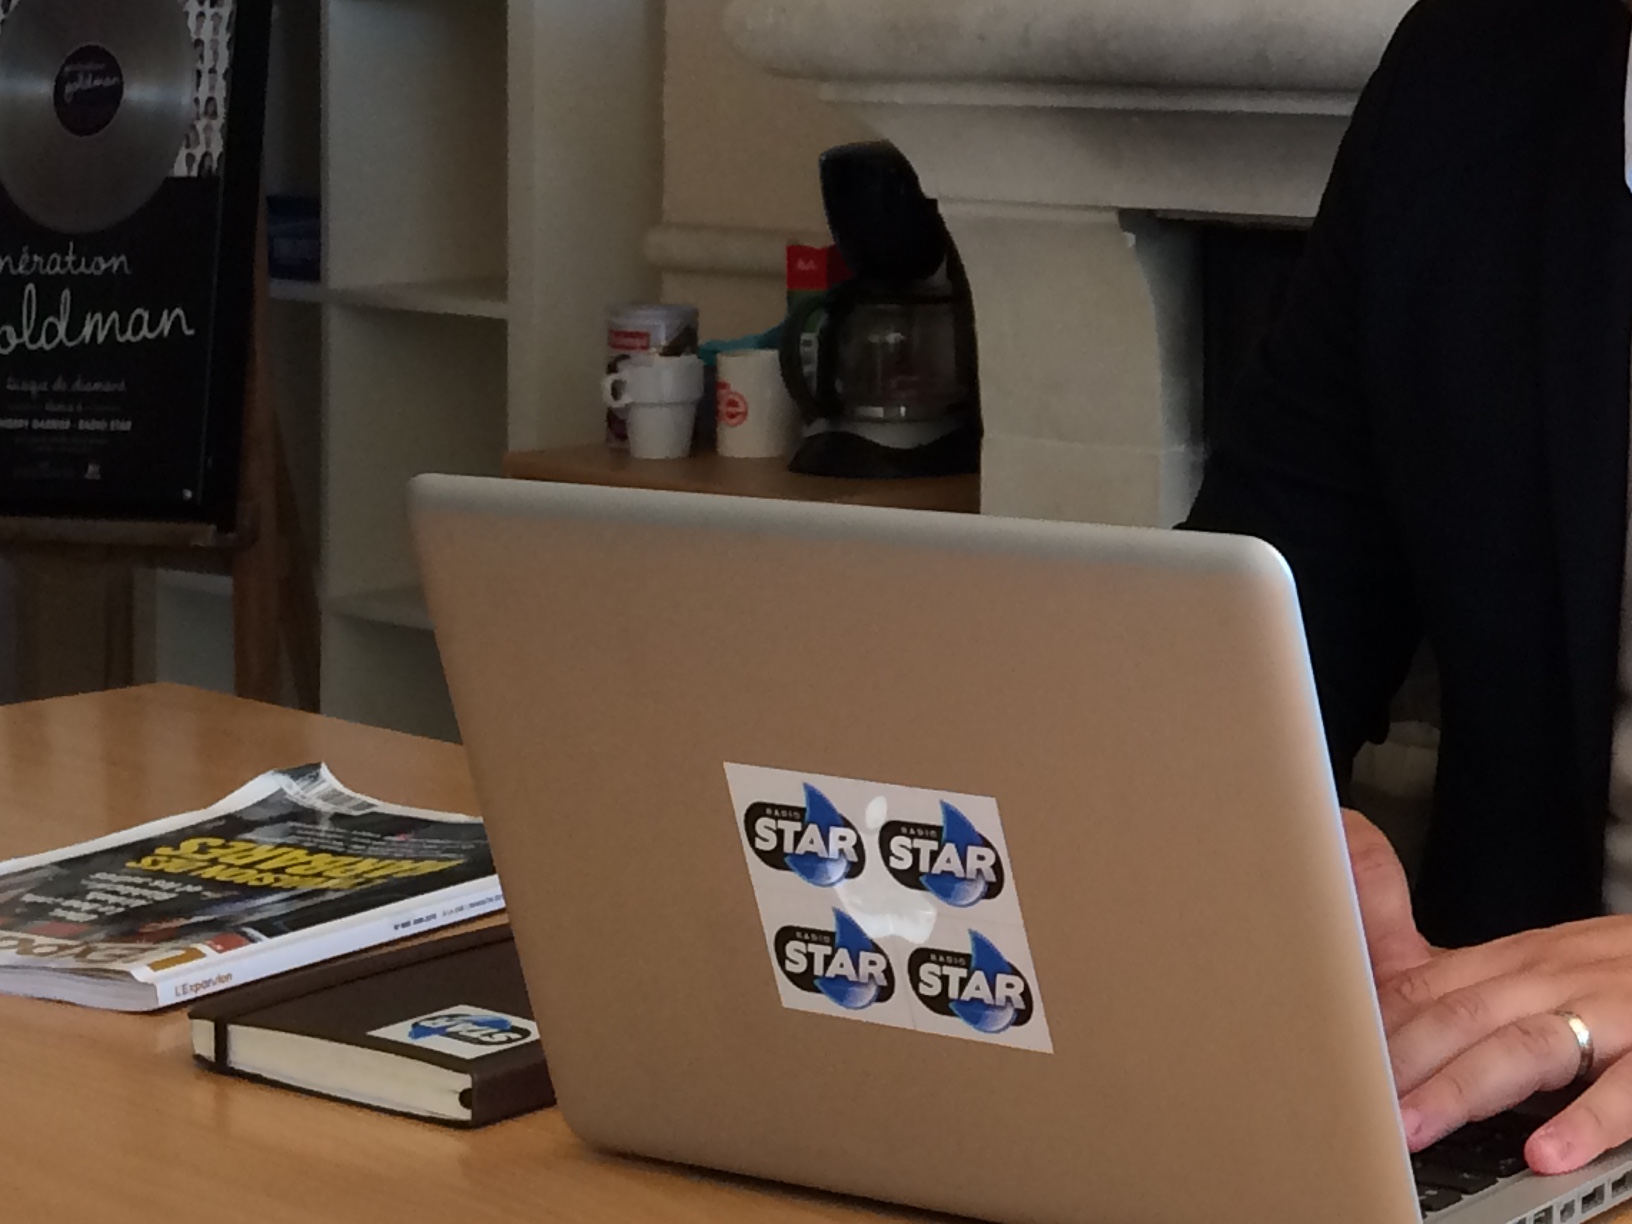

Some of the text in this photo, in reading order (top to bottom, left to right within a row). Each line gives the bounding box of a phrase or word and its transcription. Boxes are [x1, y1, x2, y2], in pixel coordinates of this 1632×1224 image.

[754, 816, 858, 862] STAR
[889, 835, 997, 882] STAR
[784, 941, 888, 986] STAR
[918, 963, 1026, 1009] STAR
